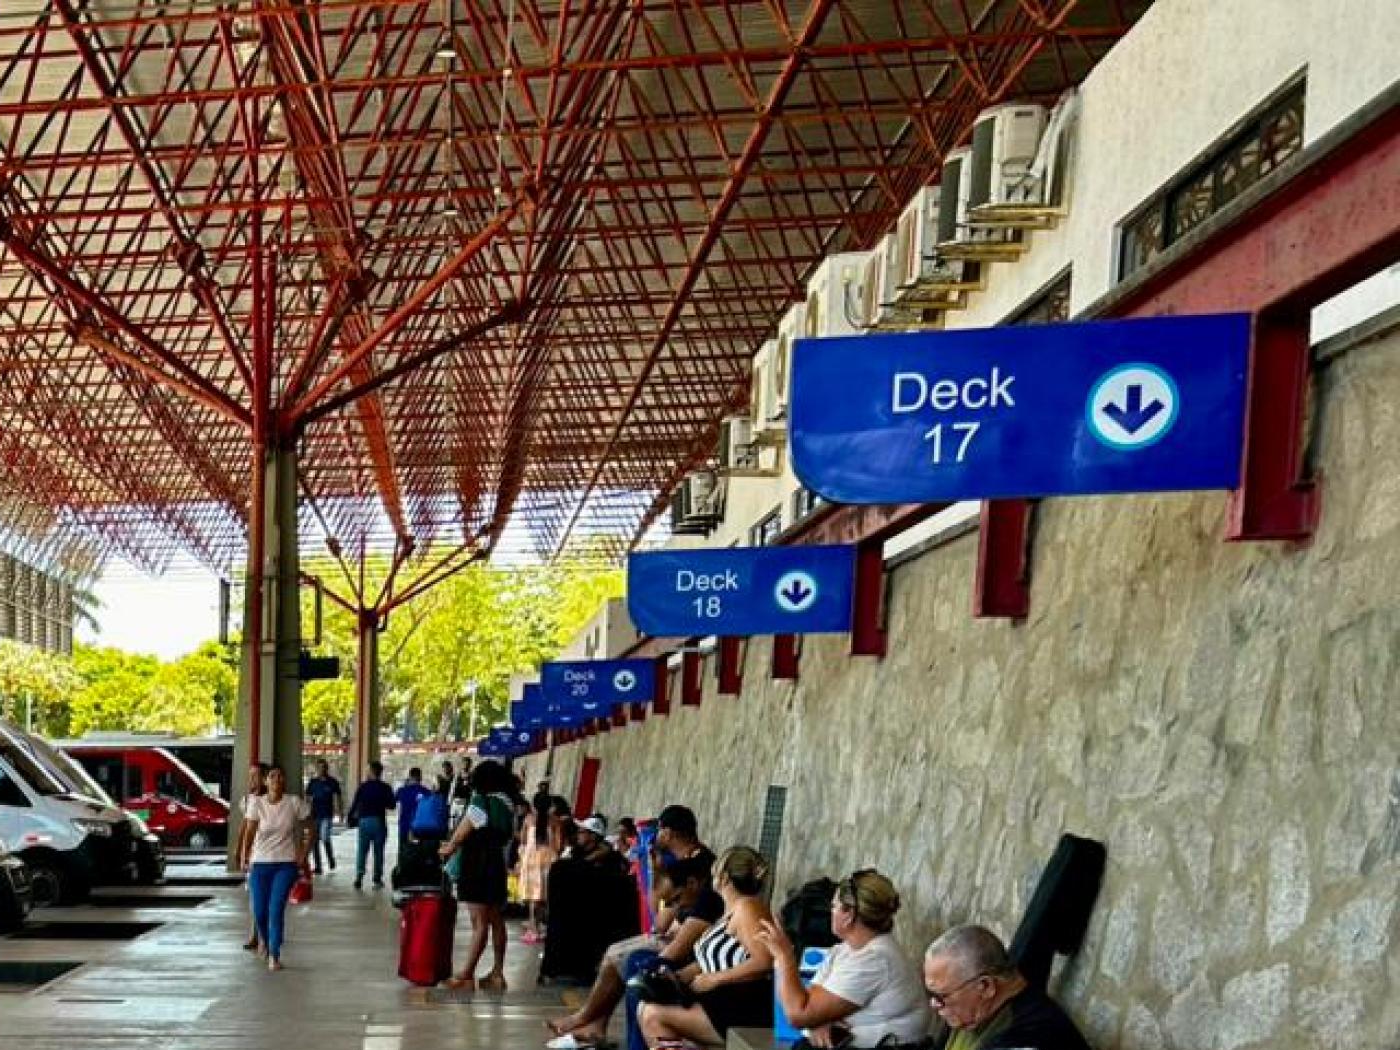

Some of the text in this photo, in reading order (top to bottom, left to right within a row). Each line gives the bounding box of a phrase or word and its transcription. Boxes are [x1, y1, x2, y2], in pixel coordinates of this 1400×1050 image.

[892, 366, 1015, 414] Deck
[923, 421, 981, 464] 17
[676, 569, 739, 591] Deck
[693, 596, 721, 618] 18
[563, 669, 595, 683] Deck
[571, 683, 589, 696] 20
